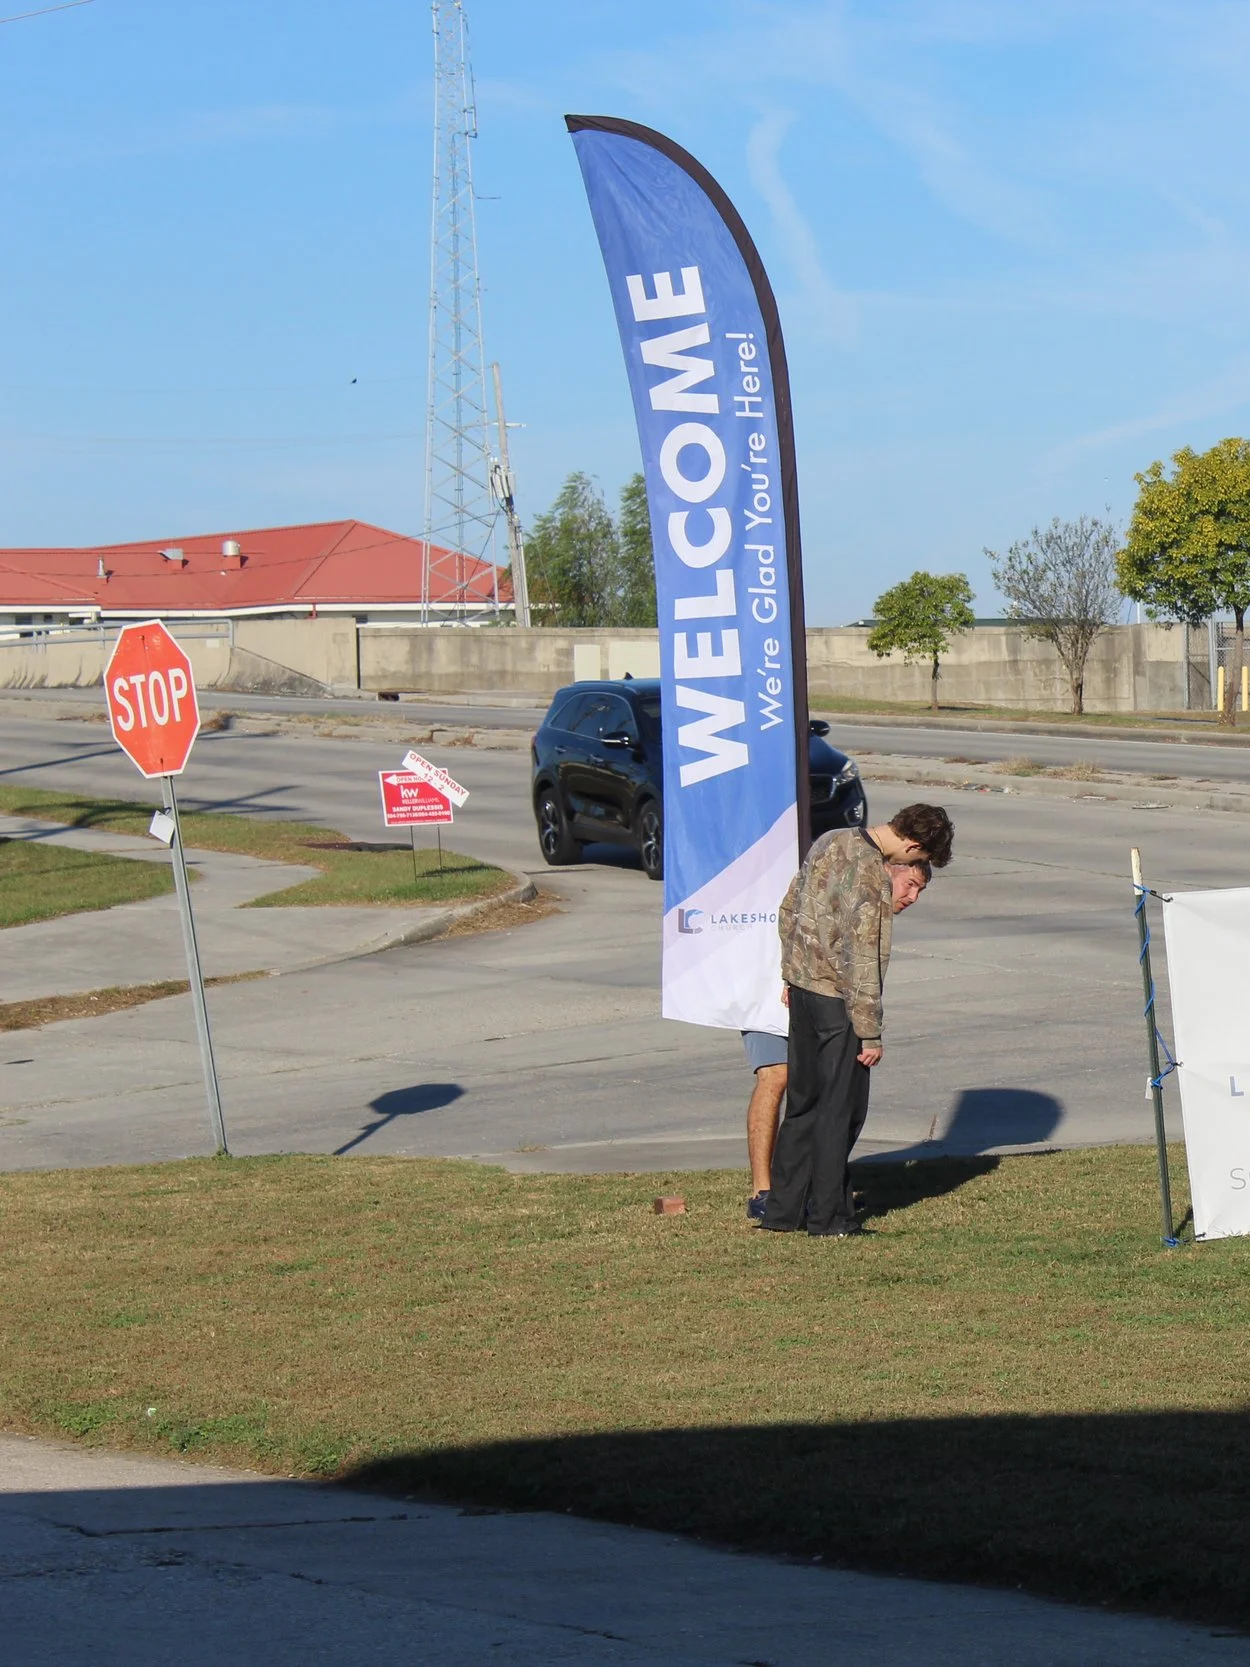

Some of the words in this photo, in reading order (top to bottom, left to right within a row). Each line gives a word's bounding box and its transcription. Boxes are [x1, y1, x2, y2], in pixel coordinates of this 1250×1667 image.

[725, 332, 764, 418] Here!
[740, 432, 773, 531] You're
[626, 266, 749, 787] WELCOME
[744, 544, 777, 624] Glad
[113, 667, 188, 732] STOP
[756, 637, 784, 731] We're
[400, 785, 418, 798] kw
[410, 753, 432, 771] OPEN
[433, 769, 467, 796] SUNDAY
[710, 913, 777, 924] LAKESHO
